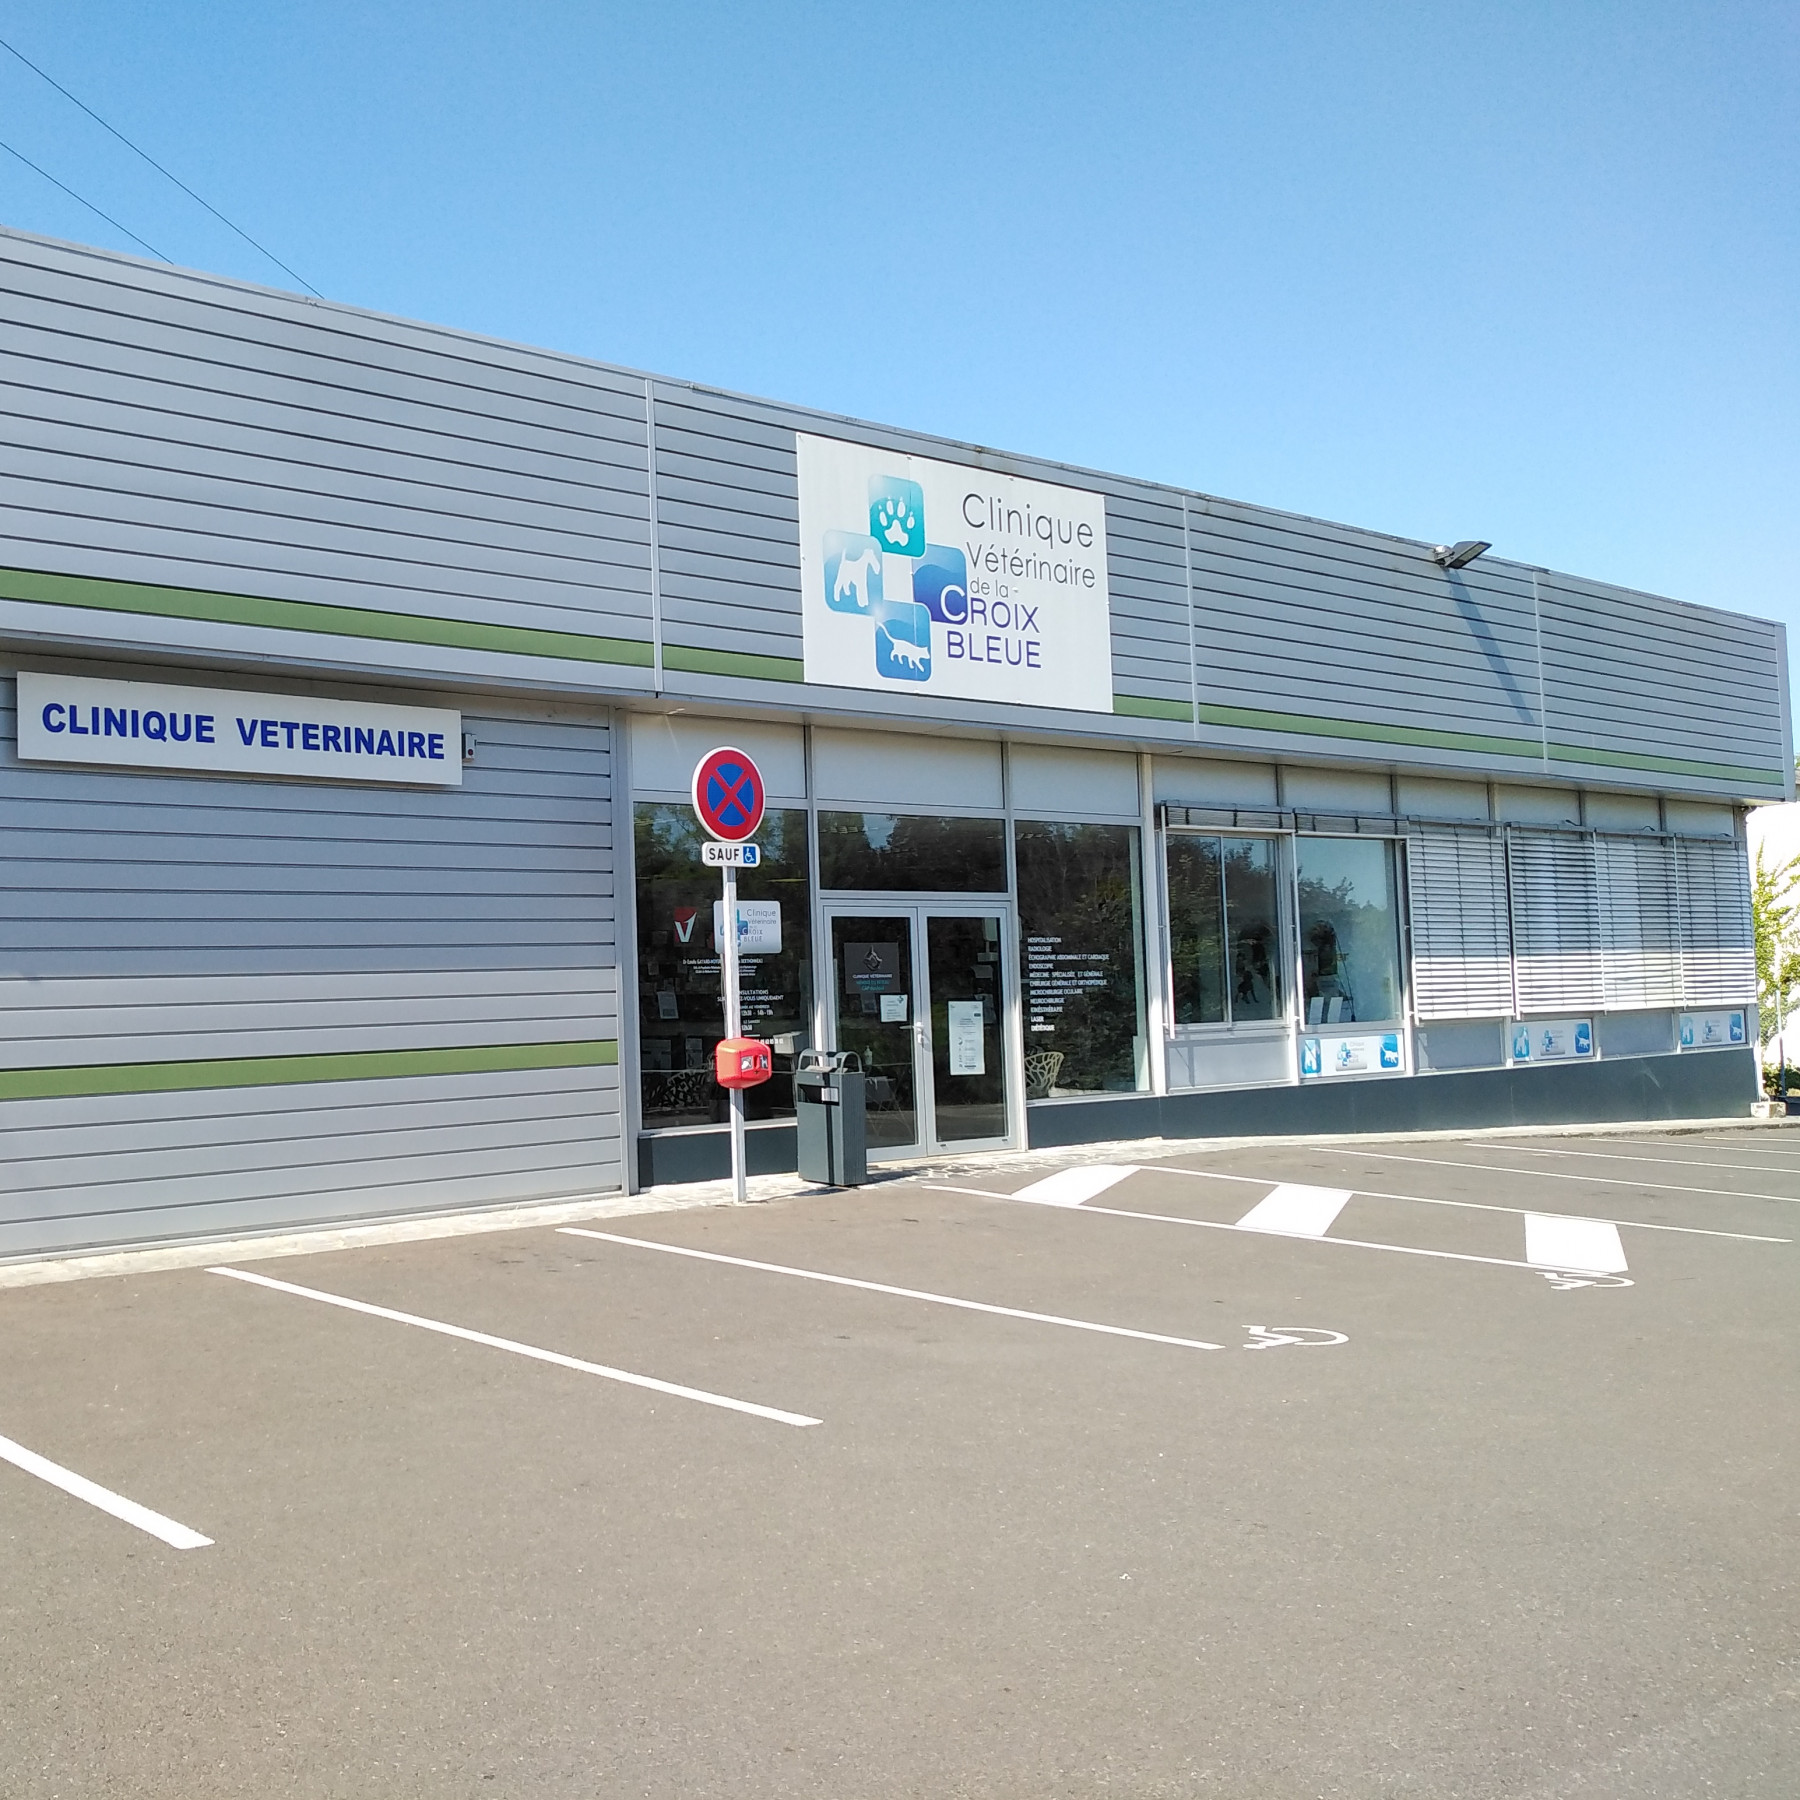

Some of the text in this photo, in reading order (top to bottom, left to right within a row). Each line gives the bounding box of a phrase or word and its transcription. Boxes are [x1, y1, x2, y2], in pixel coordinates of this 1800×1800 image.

[963, 493, 1094, 549] Clinique
[966, 541, 1096, 588] Vétérinaire
[940, 584, 1041, 633] CROIX
[970, 576, 1009, 598] de la
[947, 630, 1042, 669] BLEUE
[42, 703, 445, 760] CLINIQUE VETERINAIRE
[709, 848, 739, 861] SAUF
[747, 909, 776, 918] Clinique
